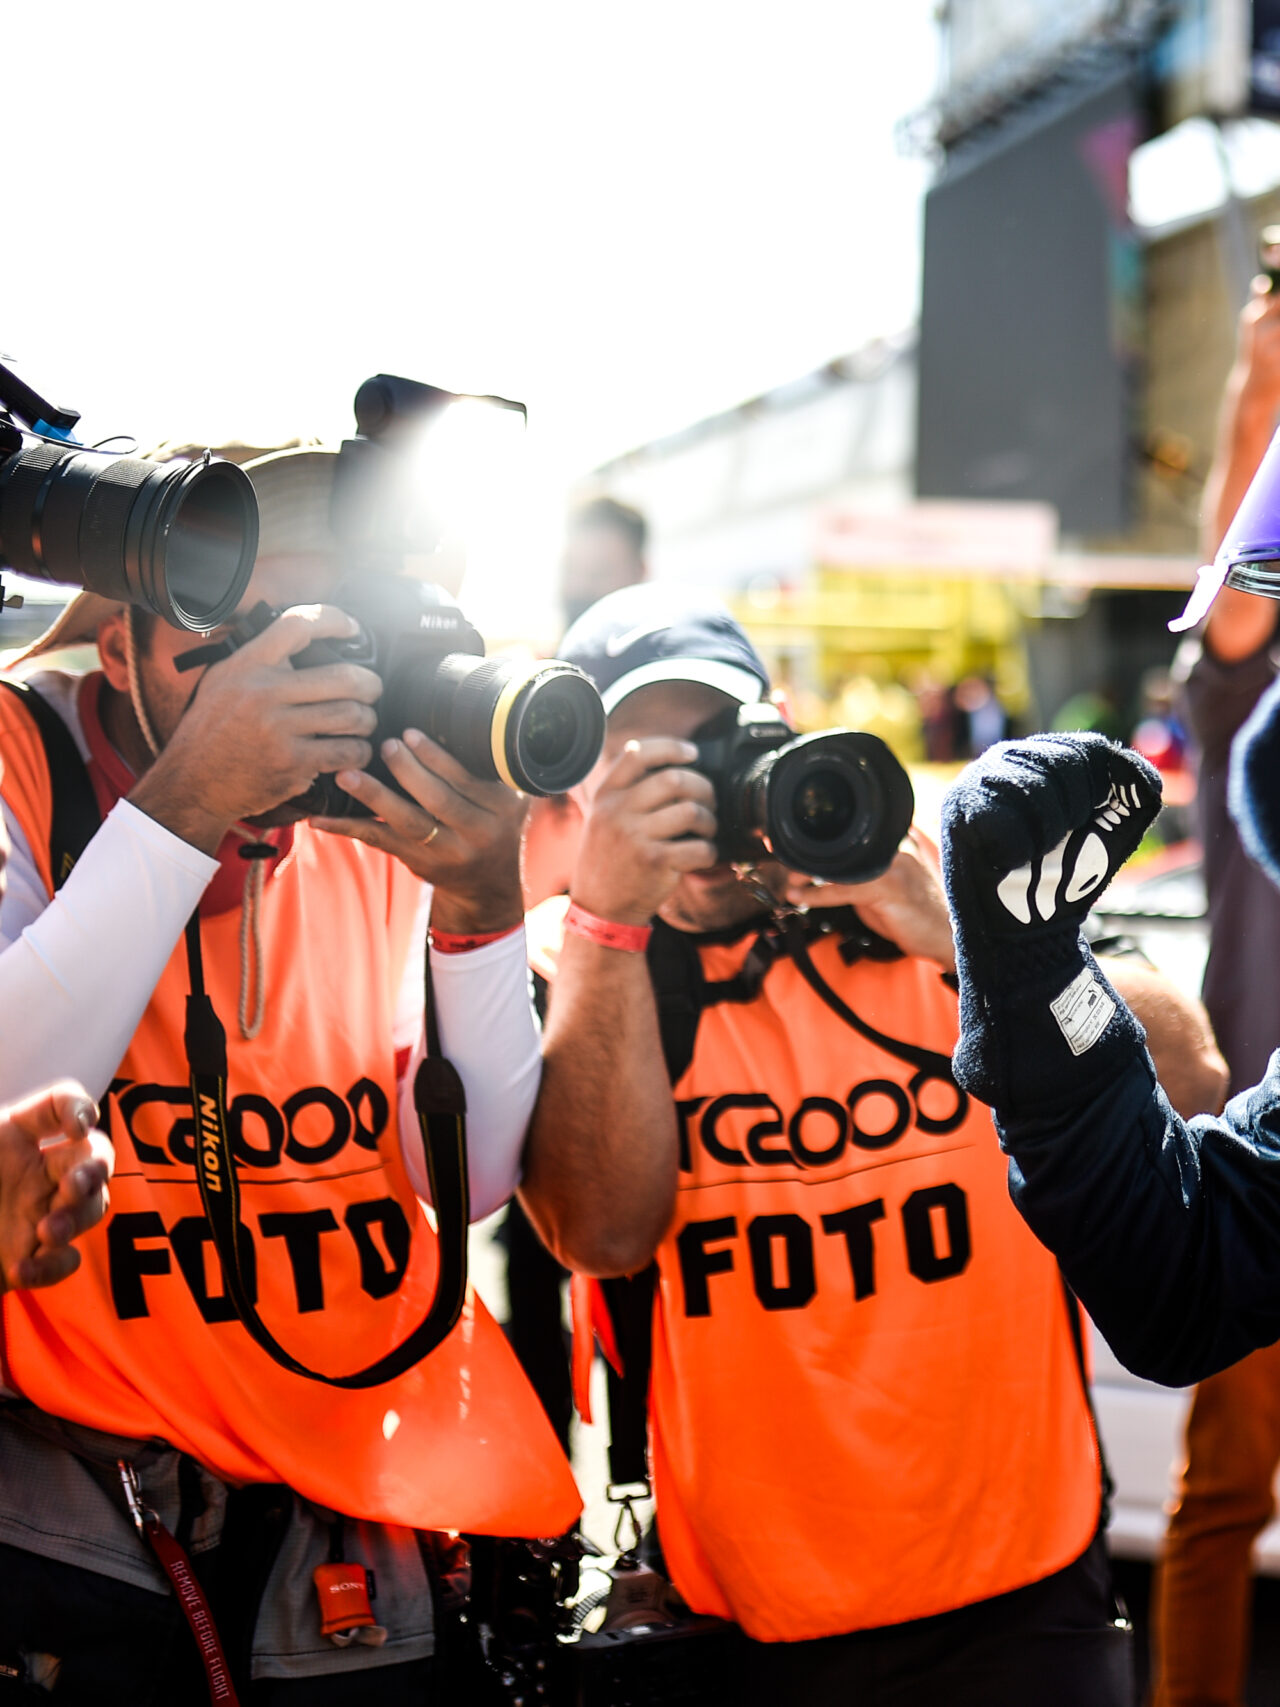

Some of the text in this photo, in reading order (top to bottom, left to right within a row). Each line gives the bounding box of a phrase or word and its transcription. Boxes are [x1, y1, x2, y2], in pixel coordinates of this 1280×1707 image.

[199, 1092, 223, 1193] Nikon
[106, 1196, 412, 1325] FOTO
[676, 1181, 972, 1318] FOTO
[170, 1560, 231, 1700] REMOVE BEFORE FLIGHT
